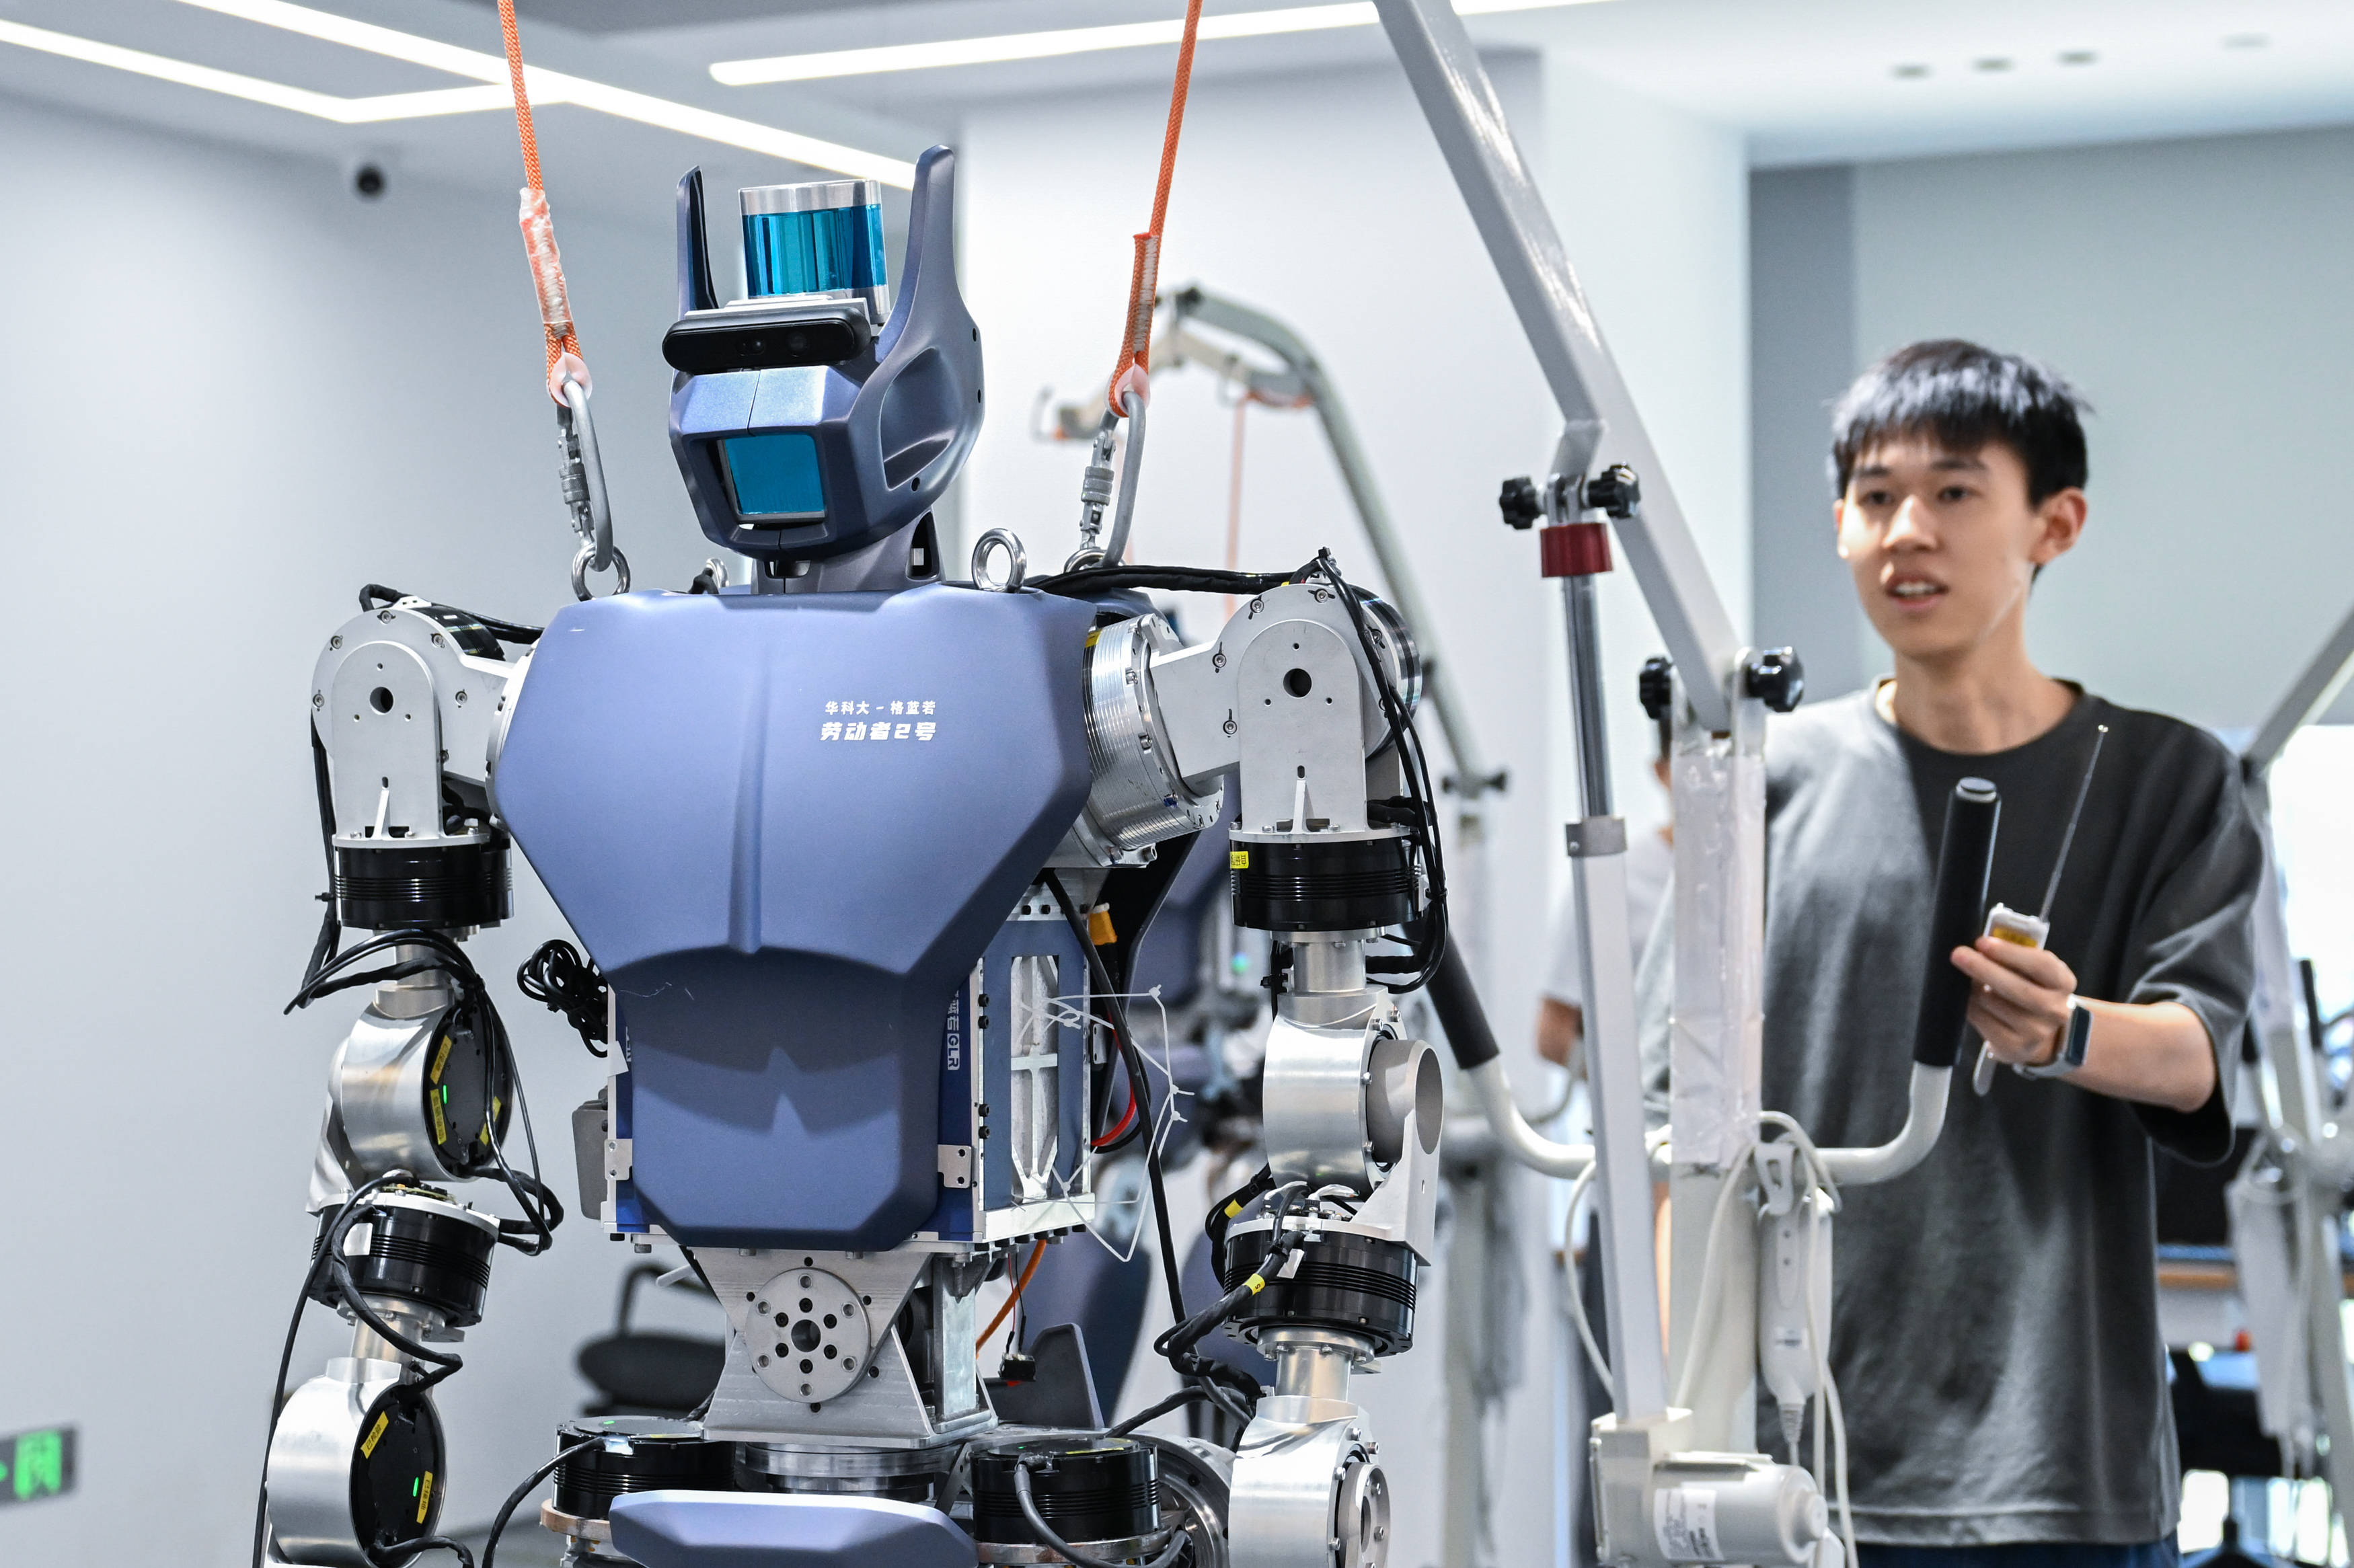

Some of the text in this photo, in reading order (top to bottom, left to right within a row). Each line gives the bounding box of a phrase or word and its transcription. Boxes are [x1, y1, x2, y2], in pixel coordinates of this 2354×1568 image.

[820, 721, 936, 741] 劳动者2号
[948, 1034, 959, 1068] GLR
